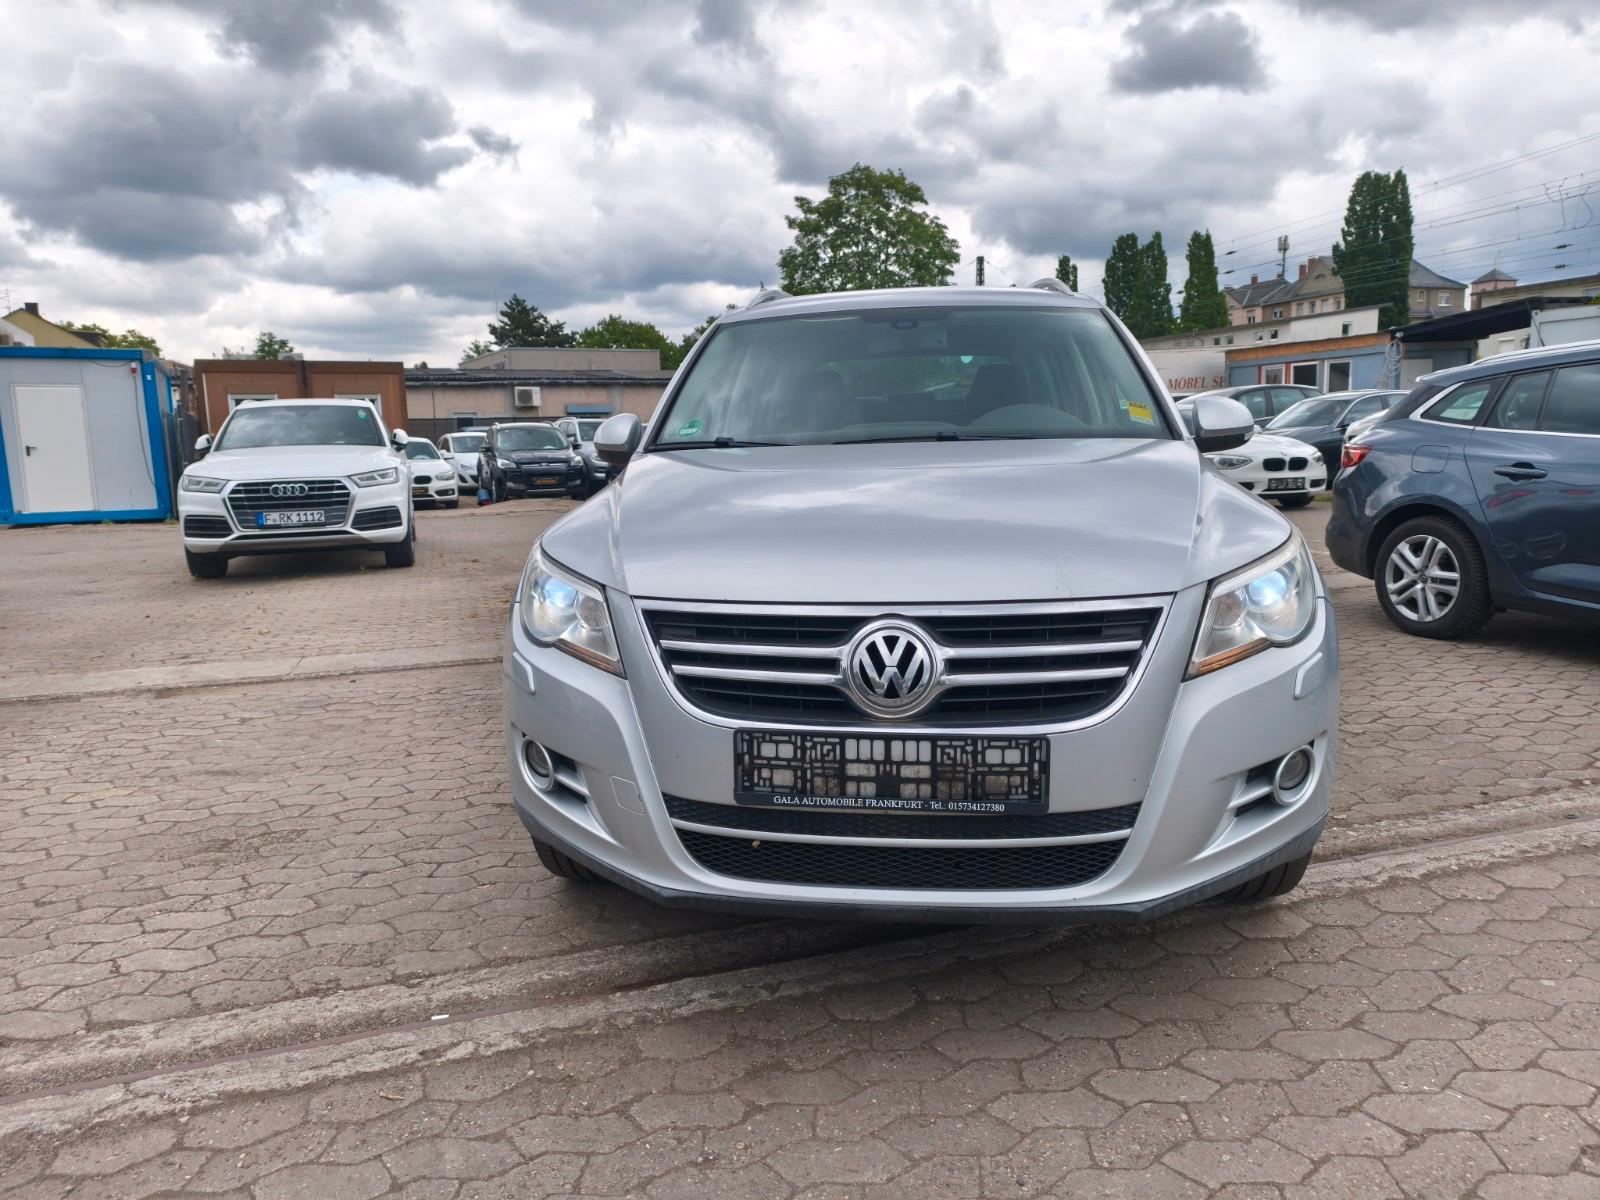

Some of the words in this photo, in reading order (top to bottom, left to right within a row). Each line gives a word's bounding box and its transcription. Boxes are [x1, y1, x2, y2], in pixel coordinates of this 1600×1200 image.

[296, 511, 323, 522] 1112
[856, 631, 927, 702] VW
[773, 796, 800, 804] GALA
[802, 797, 863, 806] AUTOMOBILE
[865, 799, 923, 809] FRANKFURT
[948, 802, 1005, 812] 015734127380
